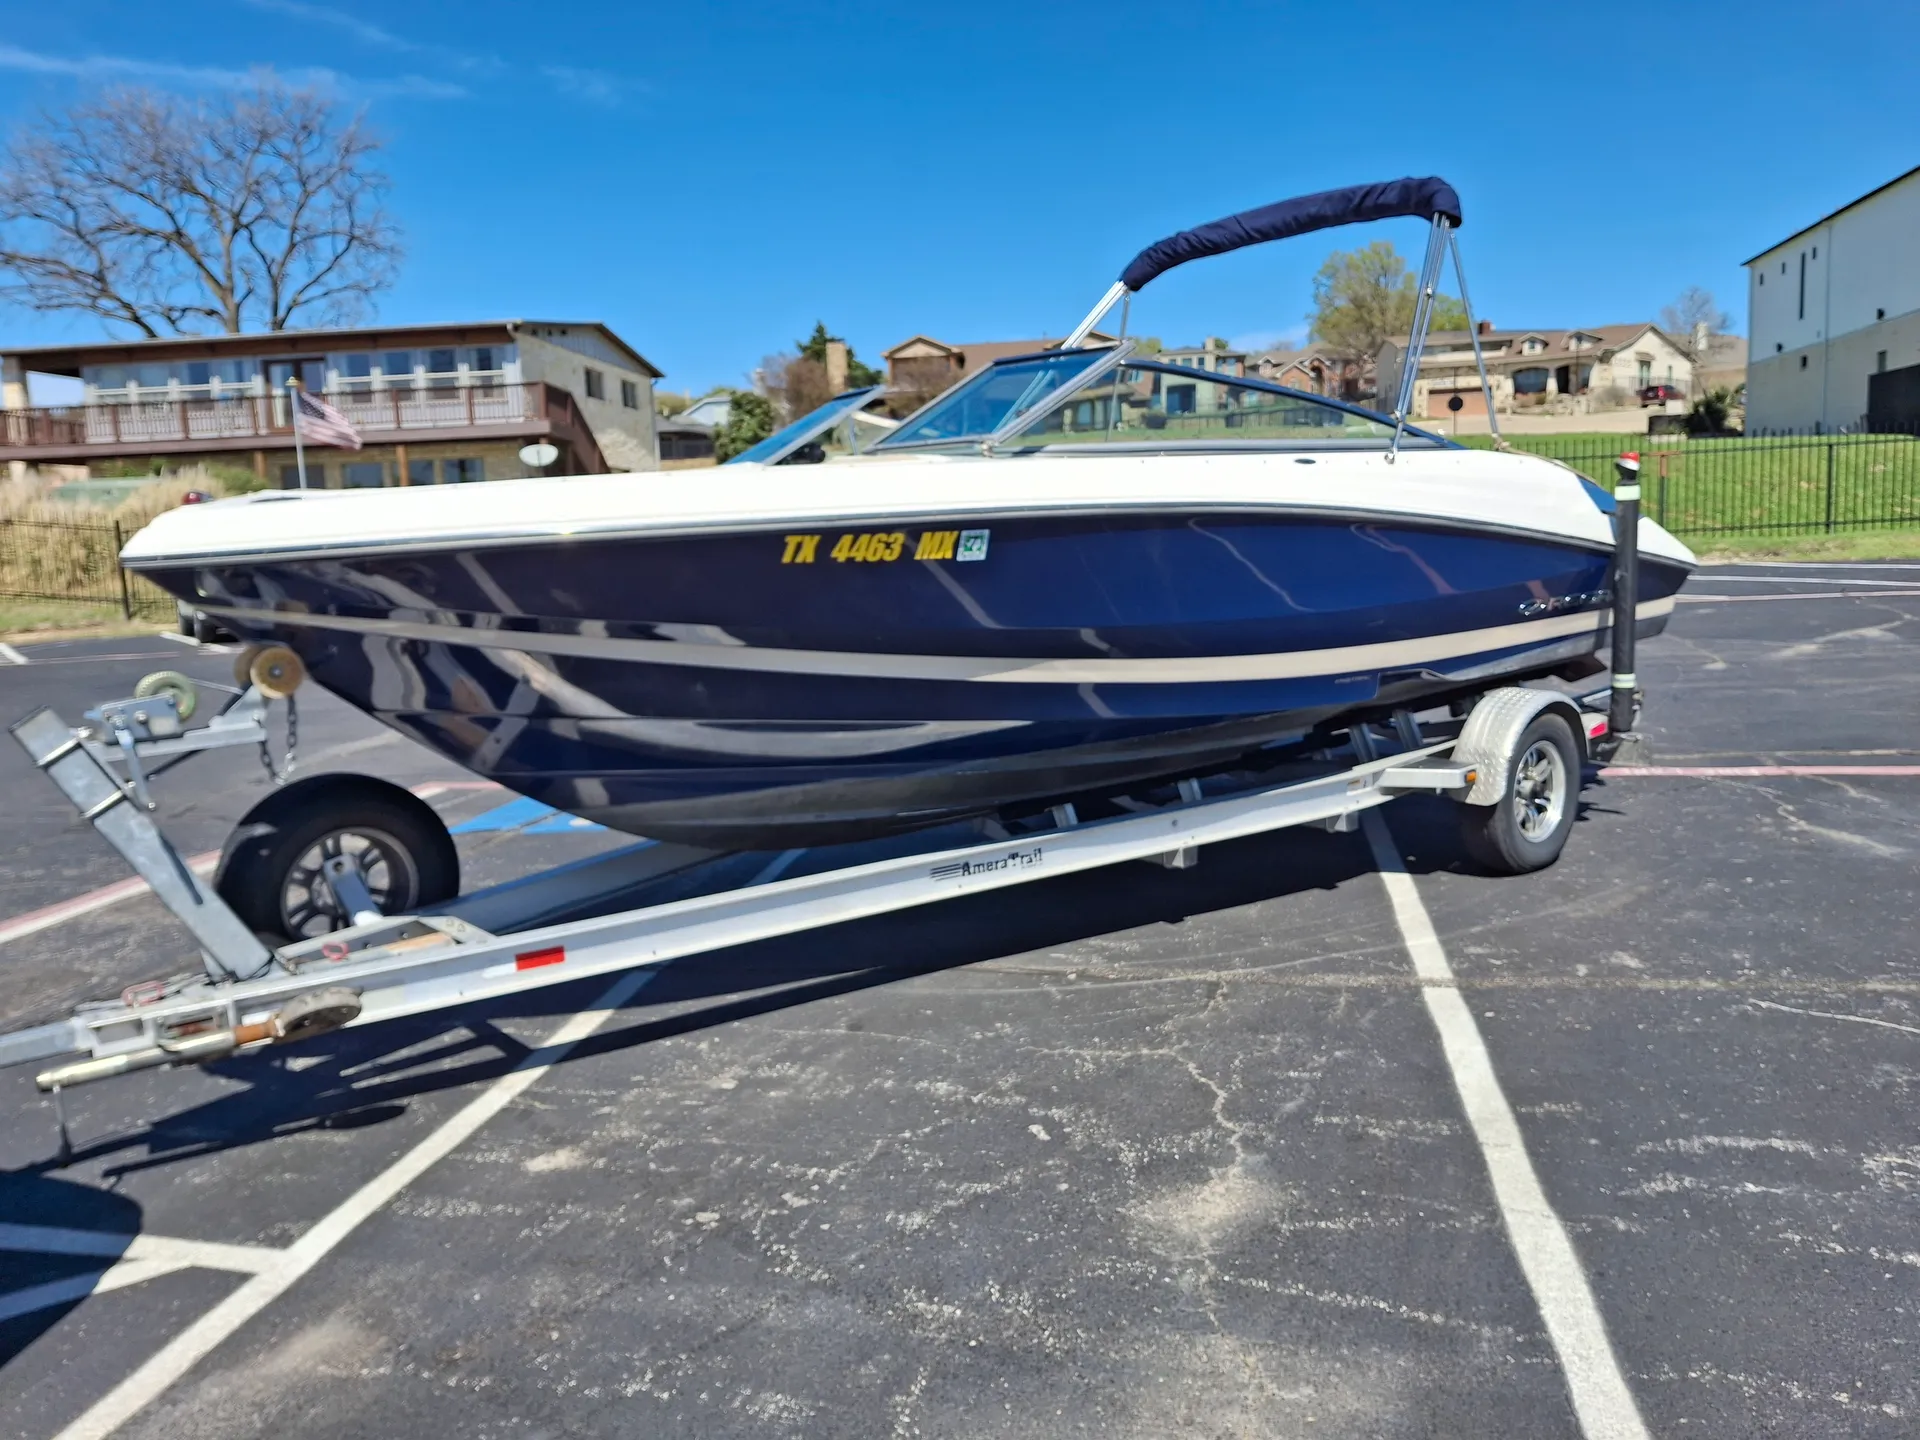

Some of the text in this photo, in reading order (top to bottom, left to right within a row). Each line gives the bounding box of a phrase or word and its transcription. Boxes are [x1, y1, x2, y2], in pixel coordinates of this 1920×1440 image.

[781, 535, 821, 563] TX
[830, 533, 904, 562] 4463
[914, 531, 959, 560] MX
